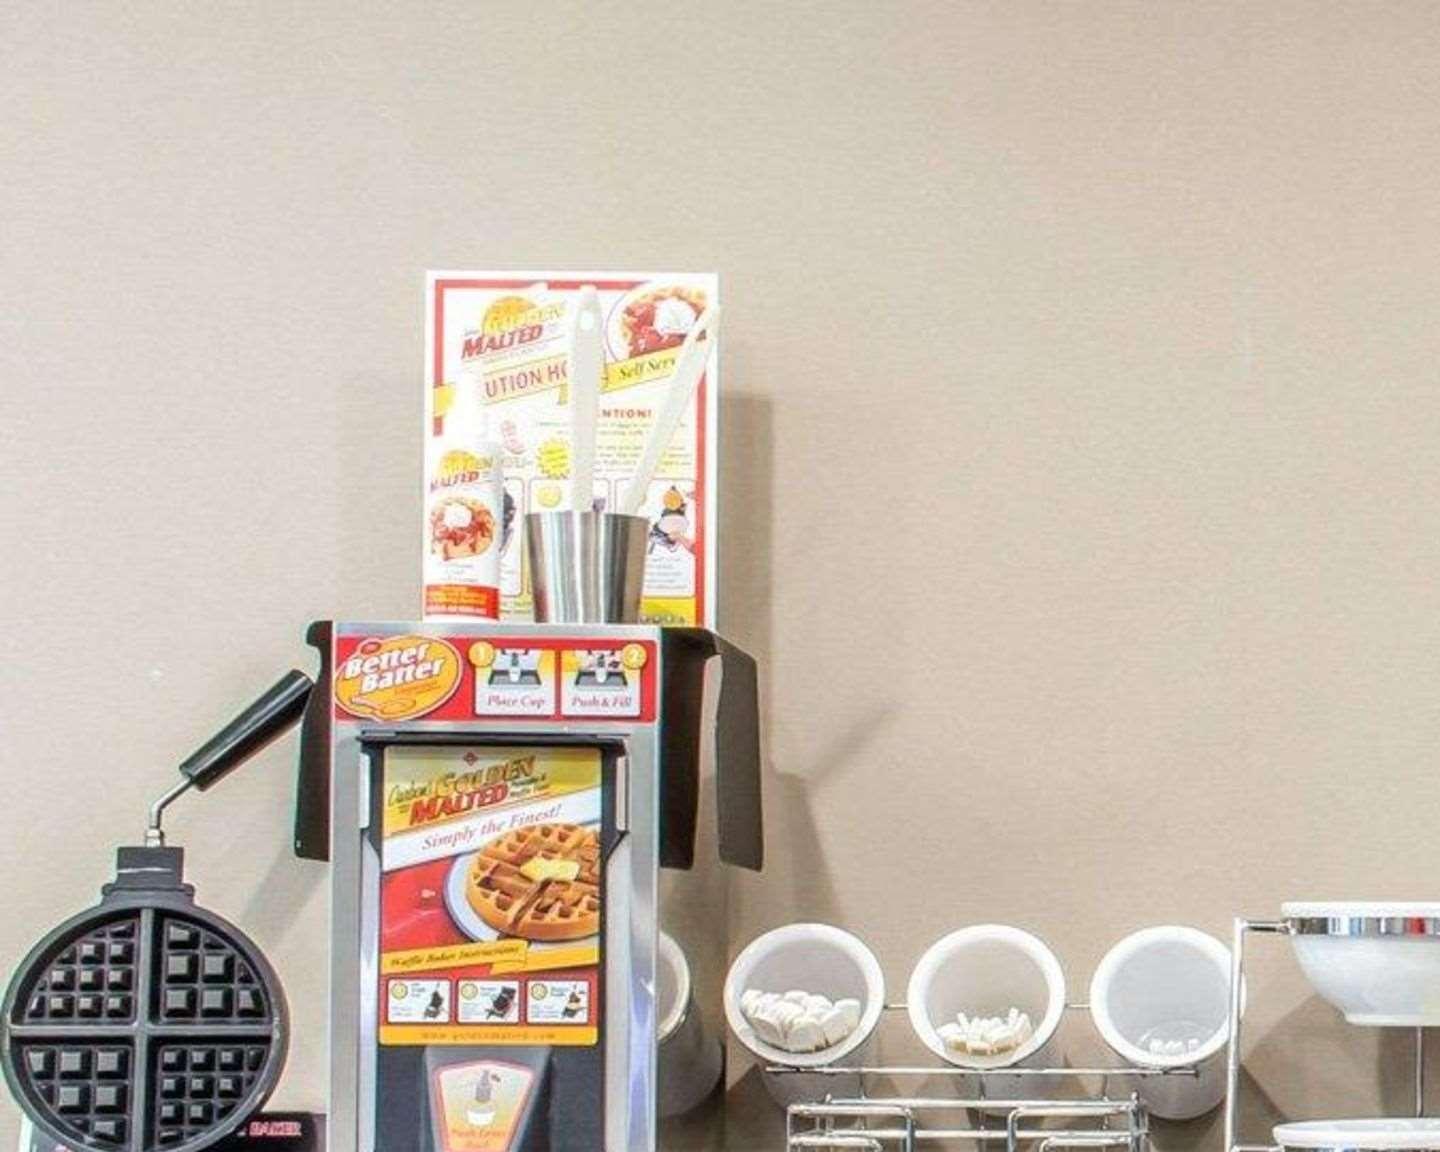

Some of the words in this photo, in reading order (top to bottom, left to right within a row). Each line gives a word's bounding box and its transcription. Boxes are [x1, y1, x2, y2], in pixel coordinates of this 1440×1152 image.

[461, 323, 543, 360] MALTED
[485, 368, 543, 398] UTION
[602, 408, 652, 419] NTION!
[344, 642, 430, 681] Better
[361, 659, 446, 695] Batter
[487, 694, 518, 706] Place
[520, 695, 545, 709] Cup
[572, 695, 599, 707] Push
[601, 696, 609, 706] &
[611, 695, 632, 707] Fill
[409, 783, 509, 827] MALTED
[422, 828, 475, 851] Simply
[480, 815, 504, 834] the
[510, 803, 562, 828] Finest!
